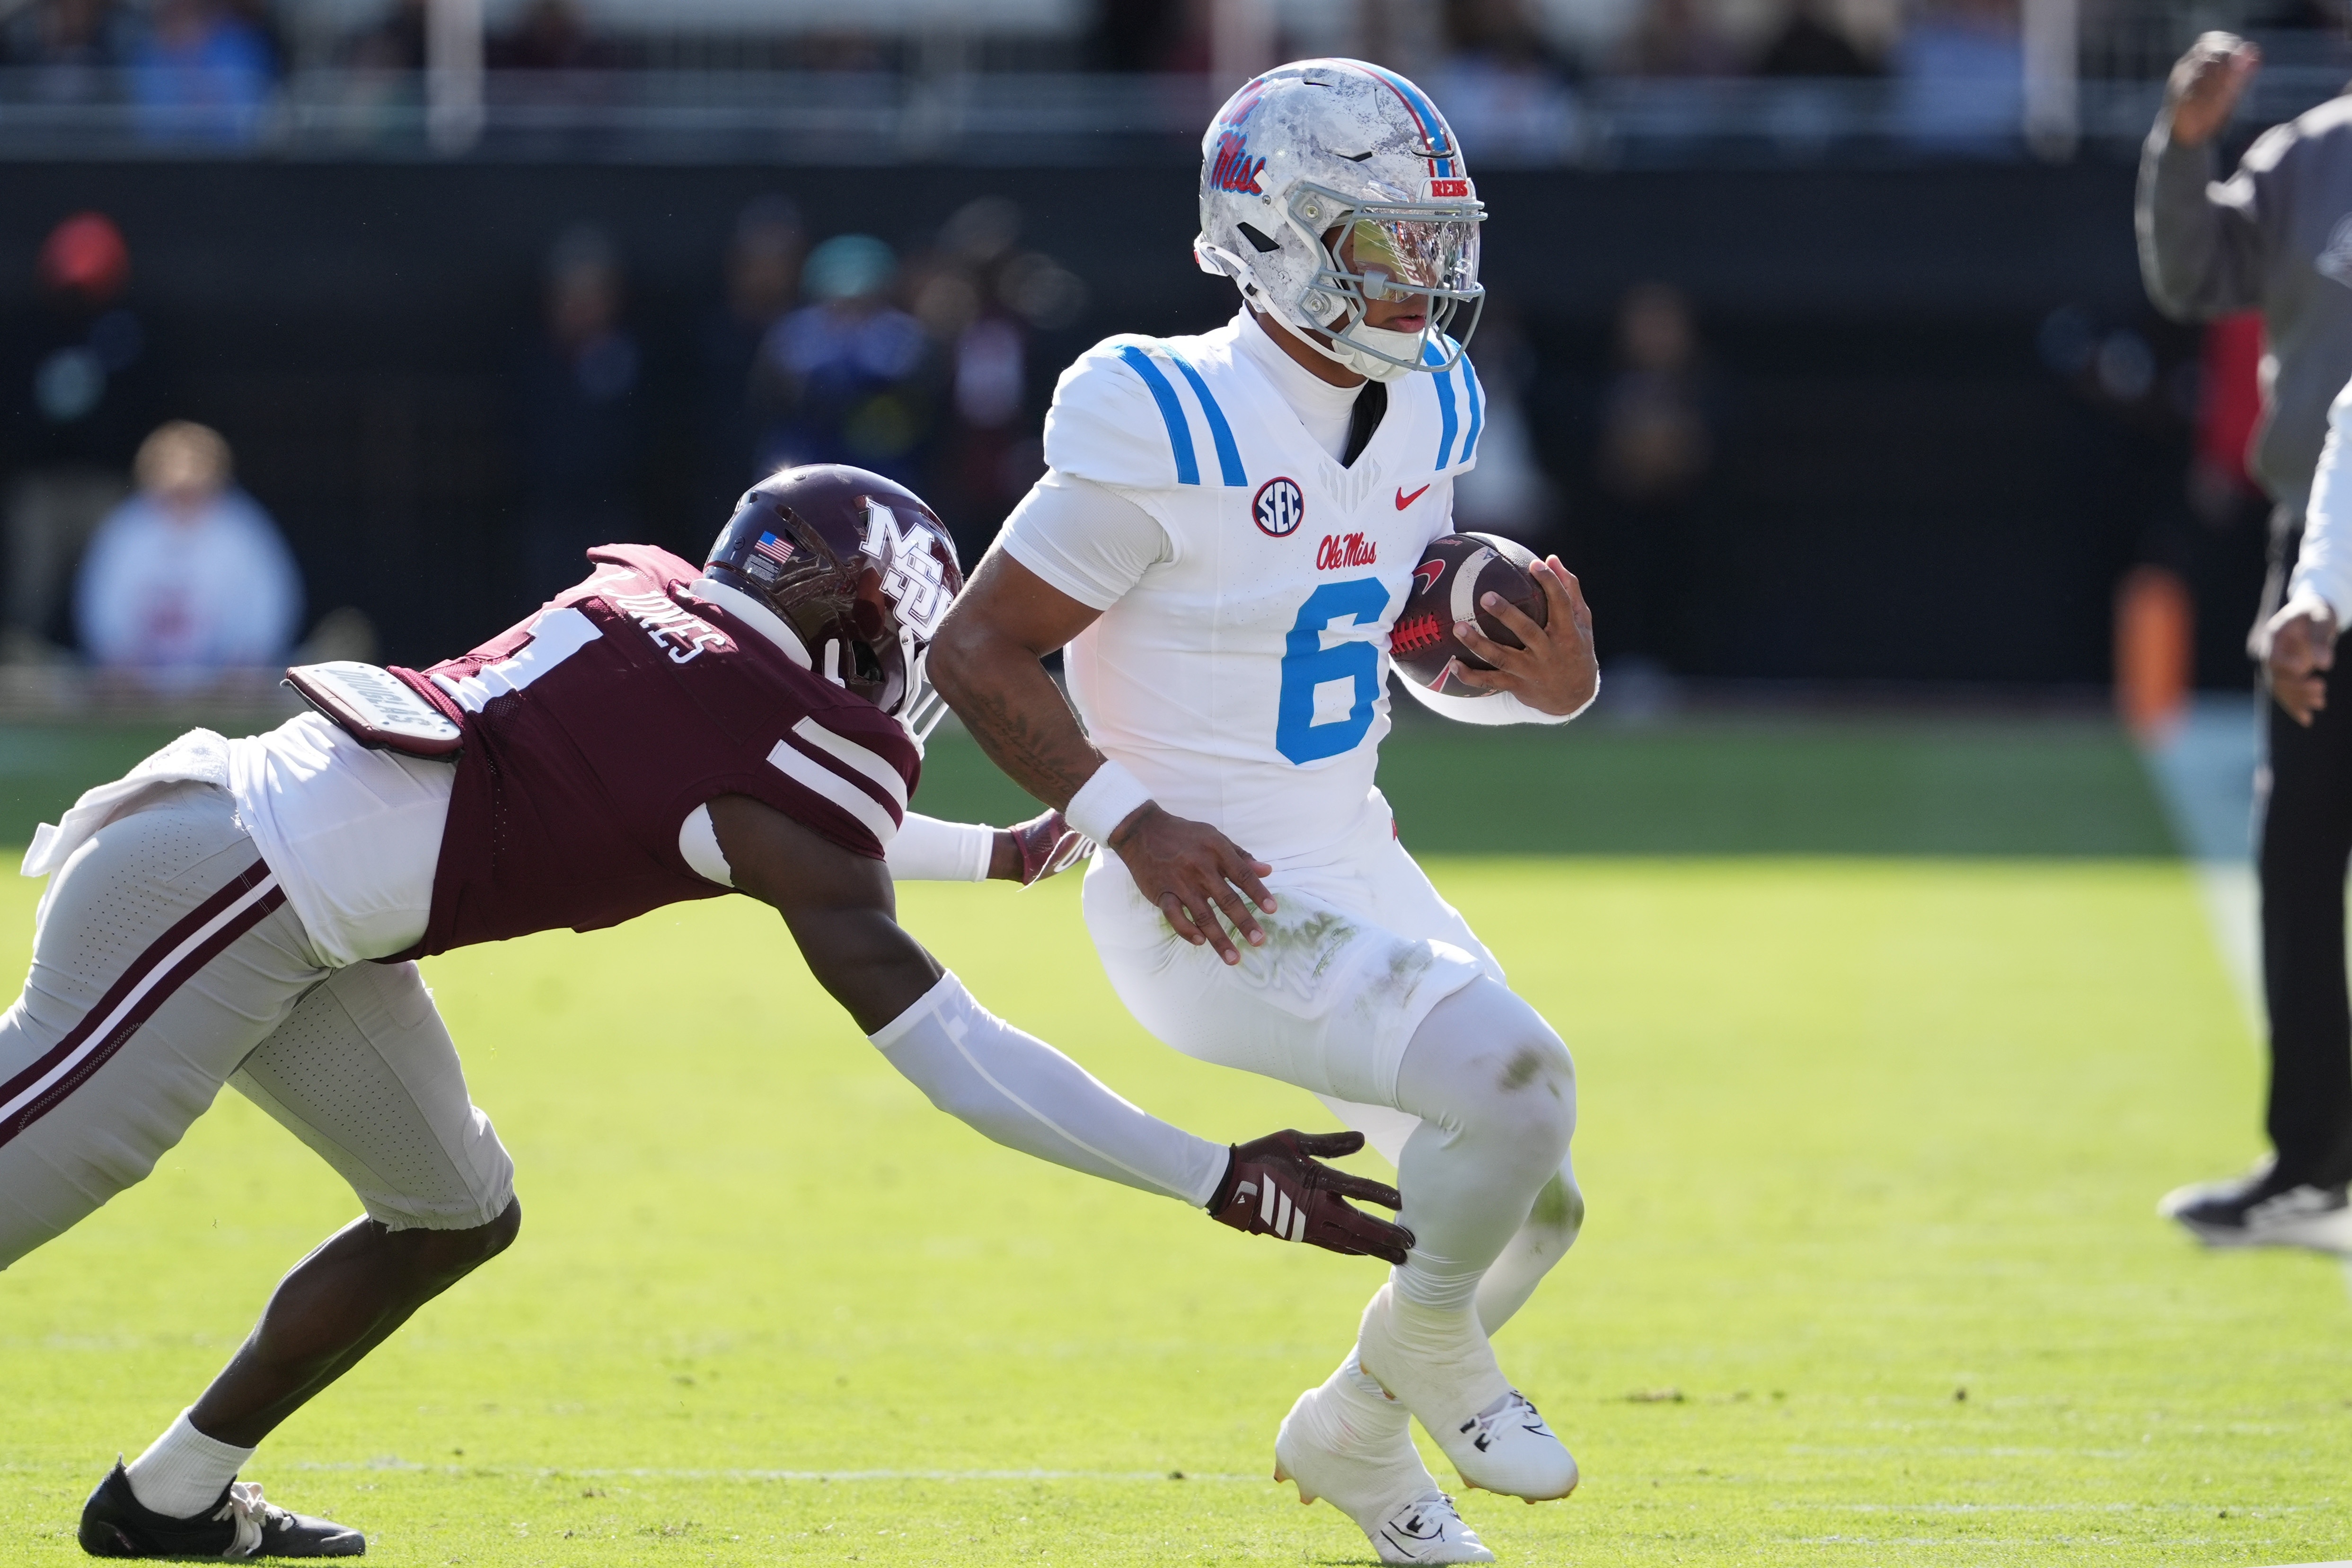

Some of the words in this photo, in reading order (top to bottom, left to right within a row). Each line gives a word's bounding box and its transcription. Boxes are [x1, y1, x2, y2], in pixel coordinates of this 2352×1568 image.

[1219, 78, 1277, 129] Ole
[1211, 130, 1266, 196] Miss
[1431, 180, 1468, 197] REBS
[1258, 482, 1301, 533] SEC
[860, 498, 955, 643] MSU
[1316, 535, 1342, 570] Ole
[1343, 531, 1376, 568] Miss
[600, 588, 726, 663] JONES
[325, 669, 434, 727] DOUGLAS
[1276, 577, 1390, 765] 6
